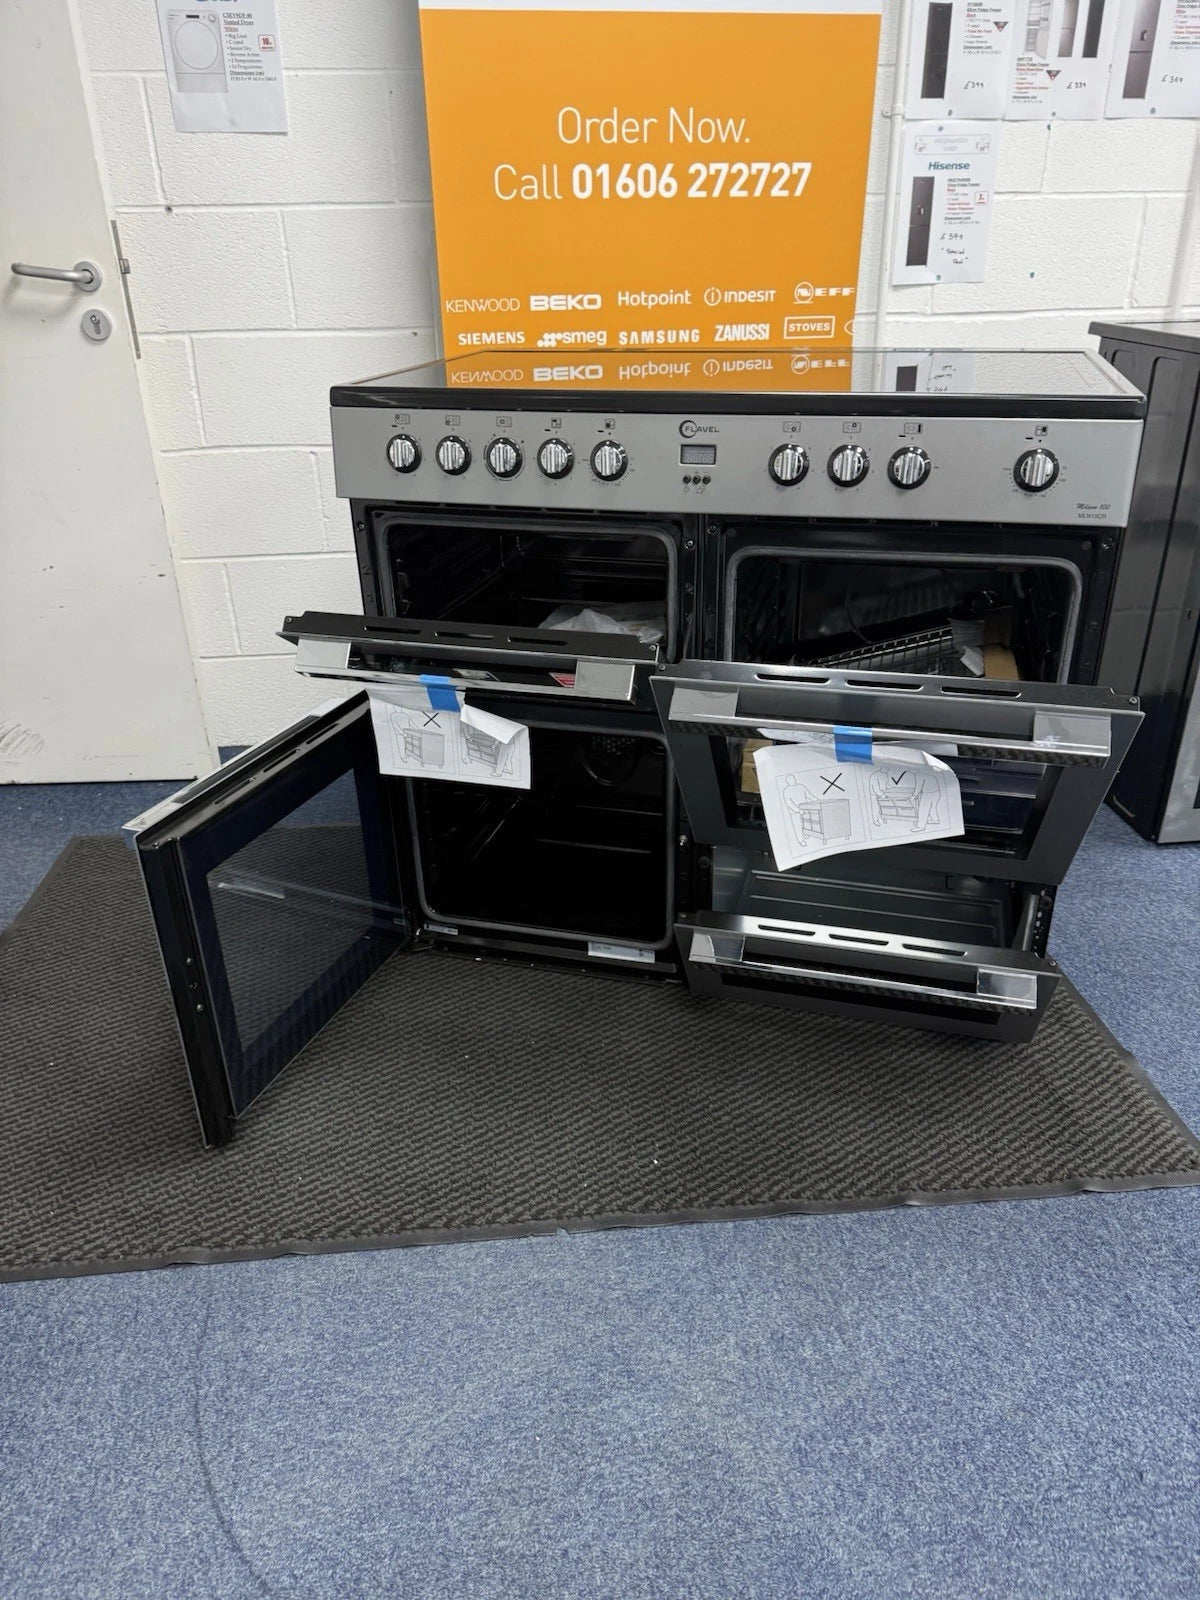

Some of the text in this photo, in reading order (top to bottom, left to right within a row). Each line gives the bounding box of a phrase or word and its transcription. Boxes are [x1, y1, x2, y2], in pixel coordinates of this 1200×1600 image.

[558, 107, 750, 144] Order Now.
[928, 161, 970, 170] Hisense
[494, 162, 812, 200] Call 01606 272727
[446, 297, 520, 313] KENWOOD
[530, 294, 601, 311] BEKO
[618, 290, 692, 308] Hotpoint
[714, 323, 770, 342] ZANUSSI
[788, 320, 831, 333] STOVES
[458, 331, 525, 346] SIEMENS
[562, 328, 607, 346] smeg
[618, 329, 700, 346] SAMSUNG
[683, 424, 720, 434] FLAVEL
